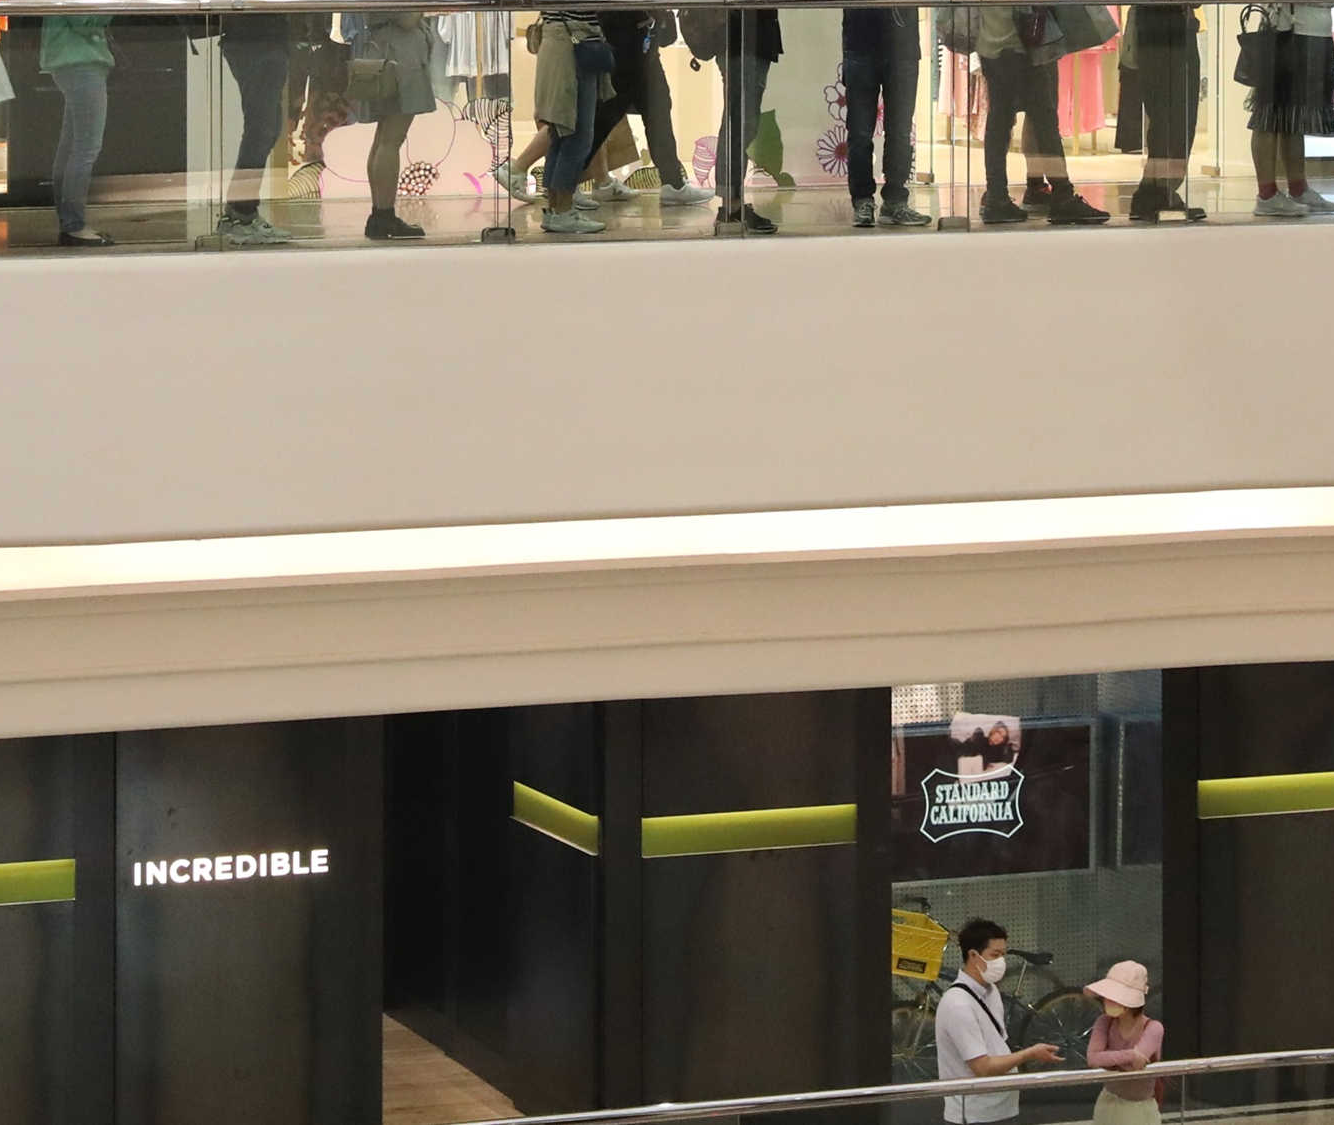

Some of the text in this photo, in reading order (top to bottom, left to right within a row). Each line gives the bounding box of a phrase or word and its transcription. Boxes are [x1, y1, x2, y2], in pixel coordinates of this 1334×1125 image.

[935, 781, 1009, 803] STANDARD
[930, 801, 1014, 825] CALIFORNIA
[133, 849, 328, 886] INCREDIBLE
